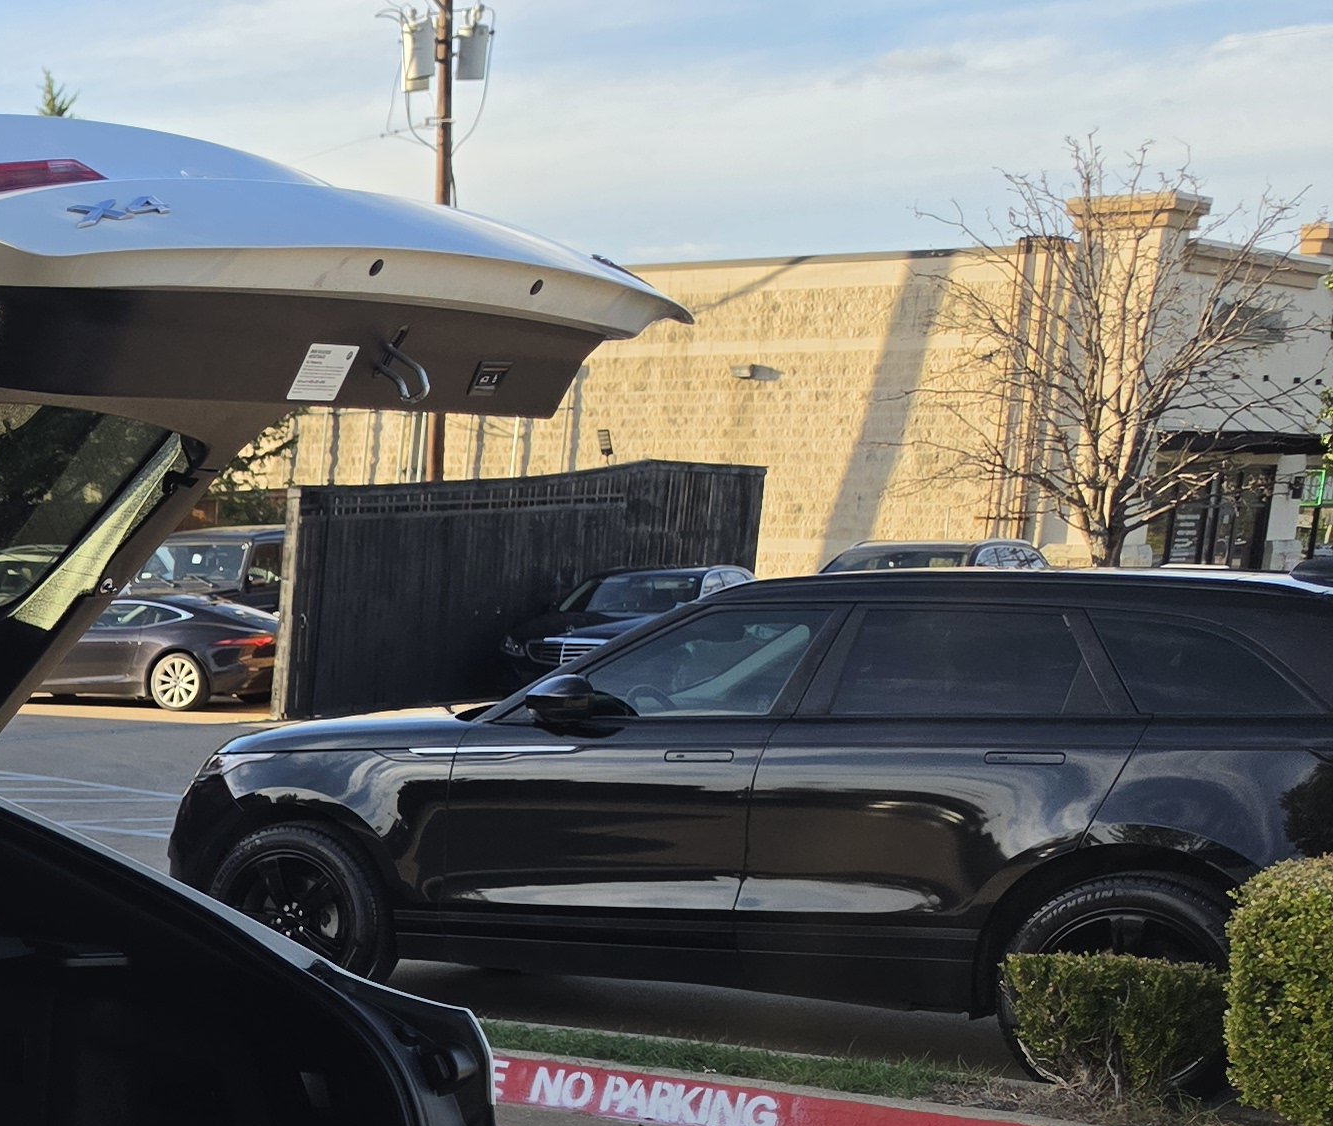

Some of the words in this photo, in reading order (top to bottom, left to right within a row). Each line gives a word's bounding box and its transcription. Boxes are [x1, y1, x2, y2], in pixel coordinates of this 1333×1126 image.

[66, 194, 172, 229] X4
[1040, 889, 1114, 925] MICHELIN
[528, 1066, 596, 1109] NO
